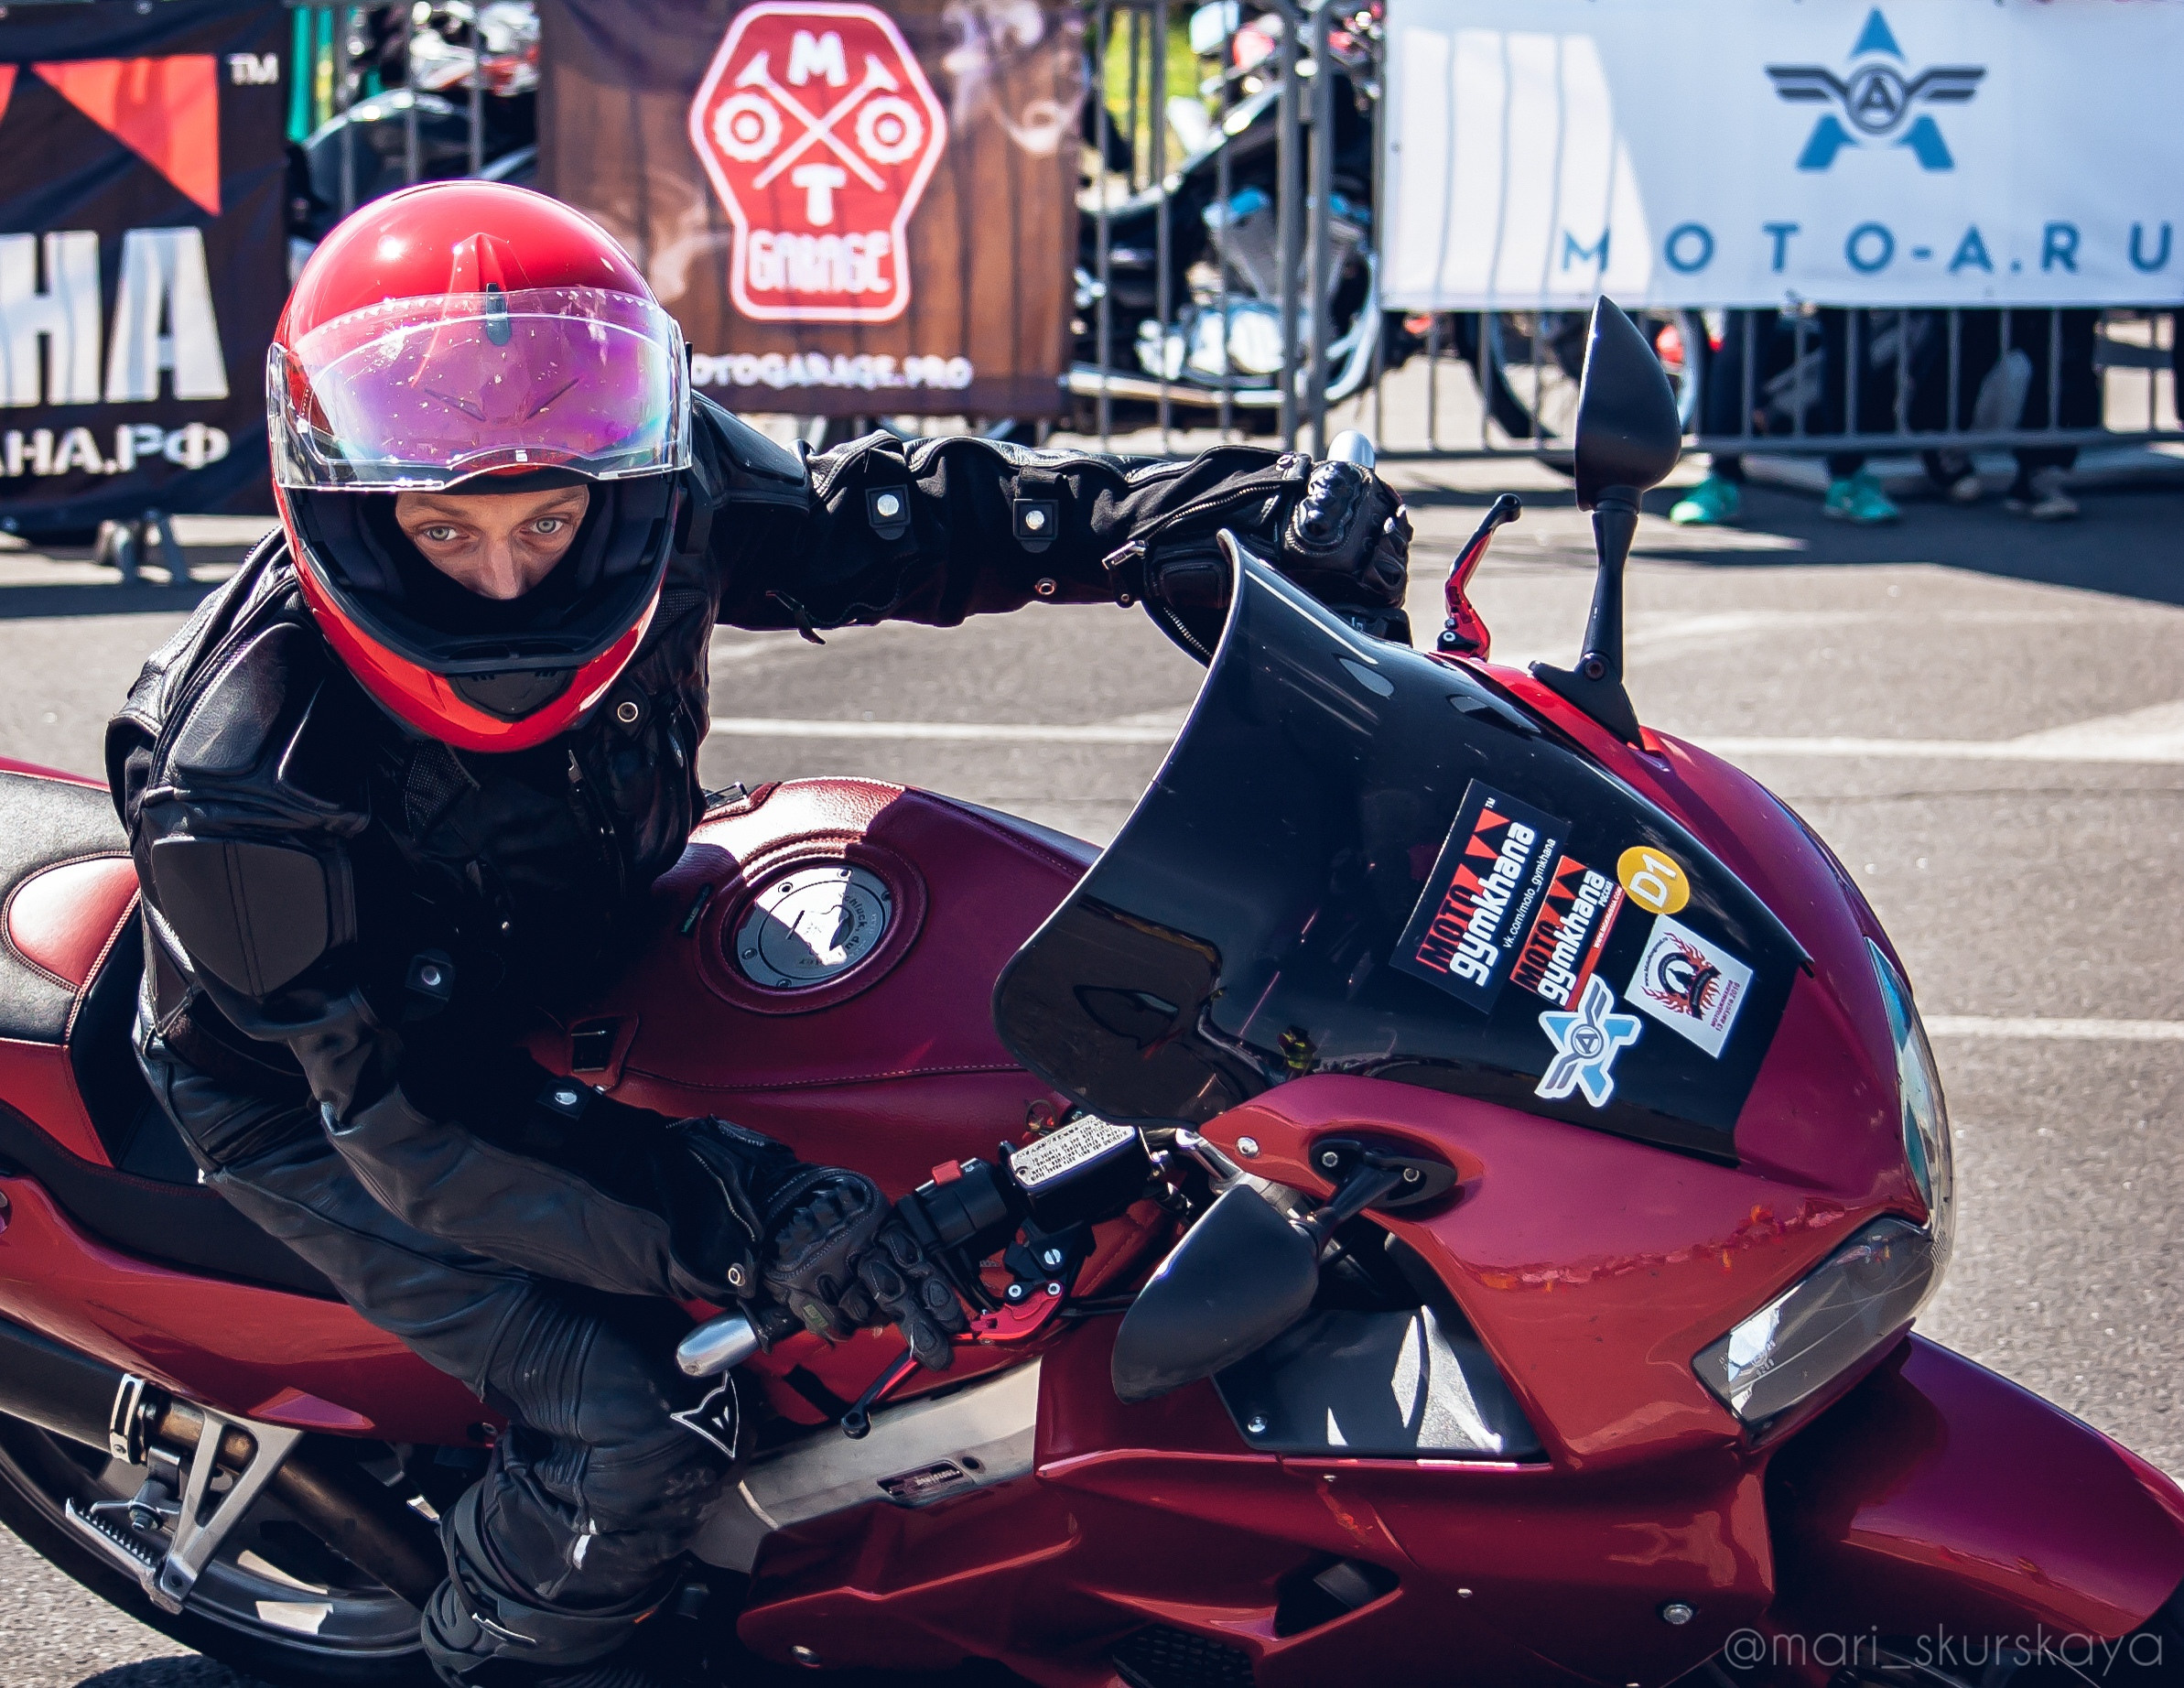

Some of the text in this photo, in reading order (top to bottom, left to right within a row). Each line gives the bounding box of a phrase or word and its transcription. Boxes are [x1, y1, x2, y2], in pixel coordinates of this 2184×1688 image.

[229, 53, 278, 84] TM
[691, 352, 974, 390] OTOGARAGE.PRO
[0, 421, 230, 477] НА.РФ
[840, 892, 867, 932] chluck,
[1449, 821, 1536, 988] gymkhana
[1502, 837, 1556, 949] vk.com/moto_gymkhana
[1628, 853, 1677, 908] D1
[1420, 883, 1477, 970] MOTO
[1513, 919, 1558, 991] MOTO
[1537, 870, 1606, 1007] gymkhana
